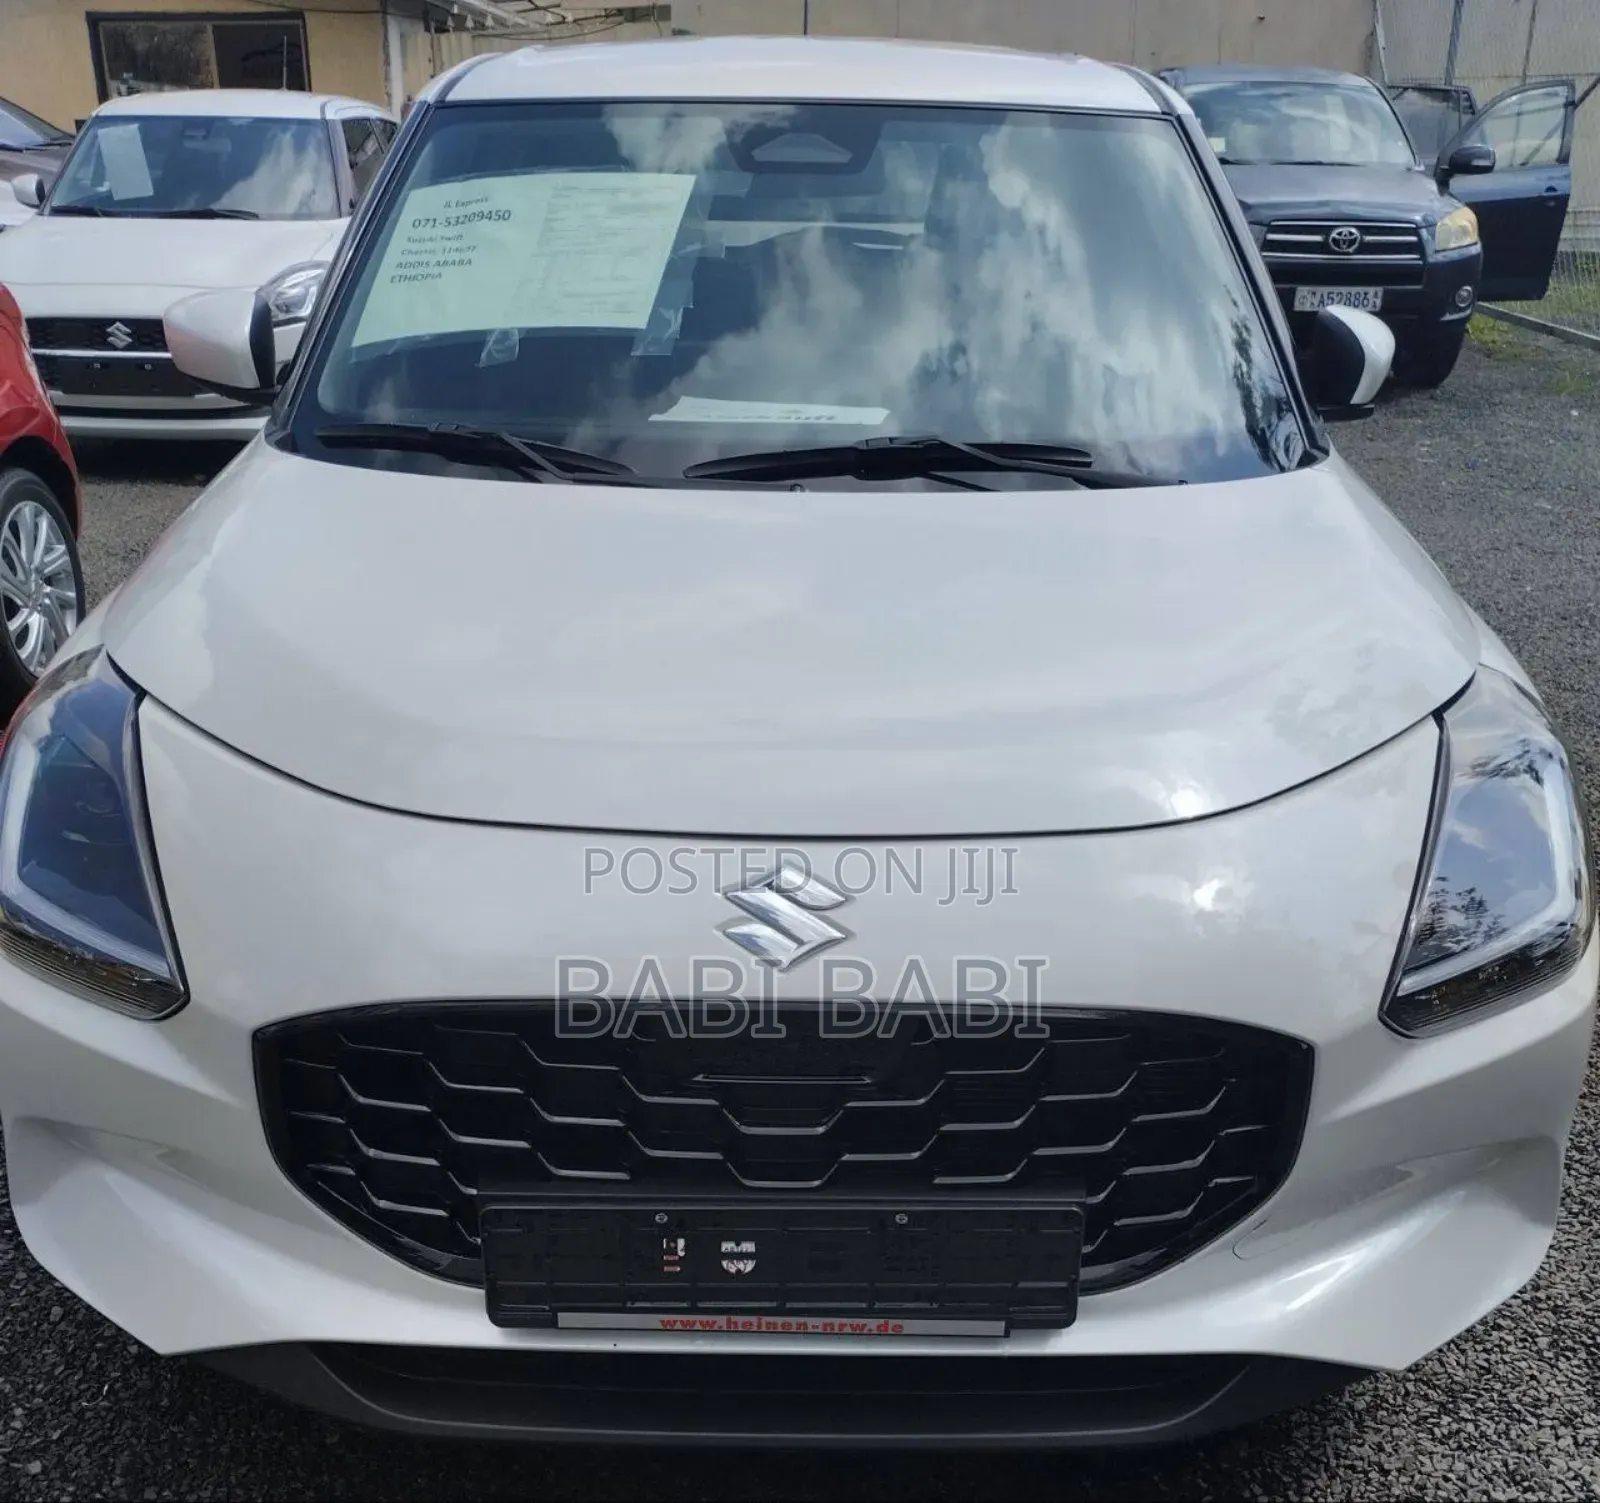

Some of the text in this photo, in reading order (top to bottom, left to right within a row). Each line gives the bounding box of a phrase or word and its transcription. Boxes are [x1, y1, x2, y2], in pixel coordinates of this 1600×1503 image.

[411, 209, 512, 229] 071-53209450
[395, 258, 472, 270] ADDIS ABABA
[390, 272, 442, 284] ETHIOPIA
[658, 1315, 905, 1335] www.heinen-nrw.de
